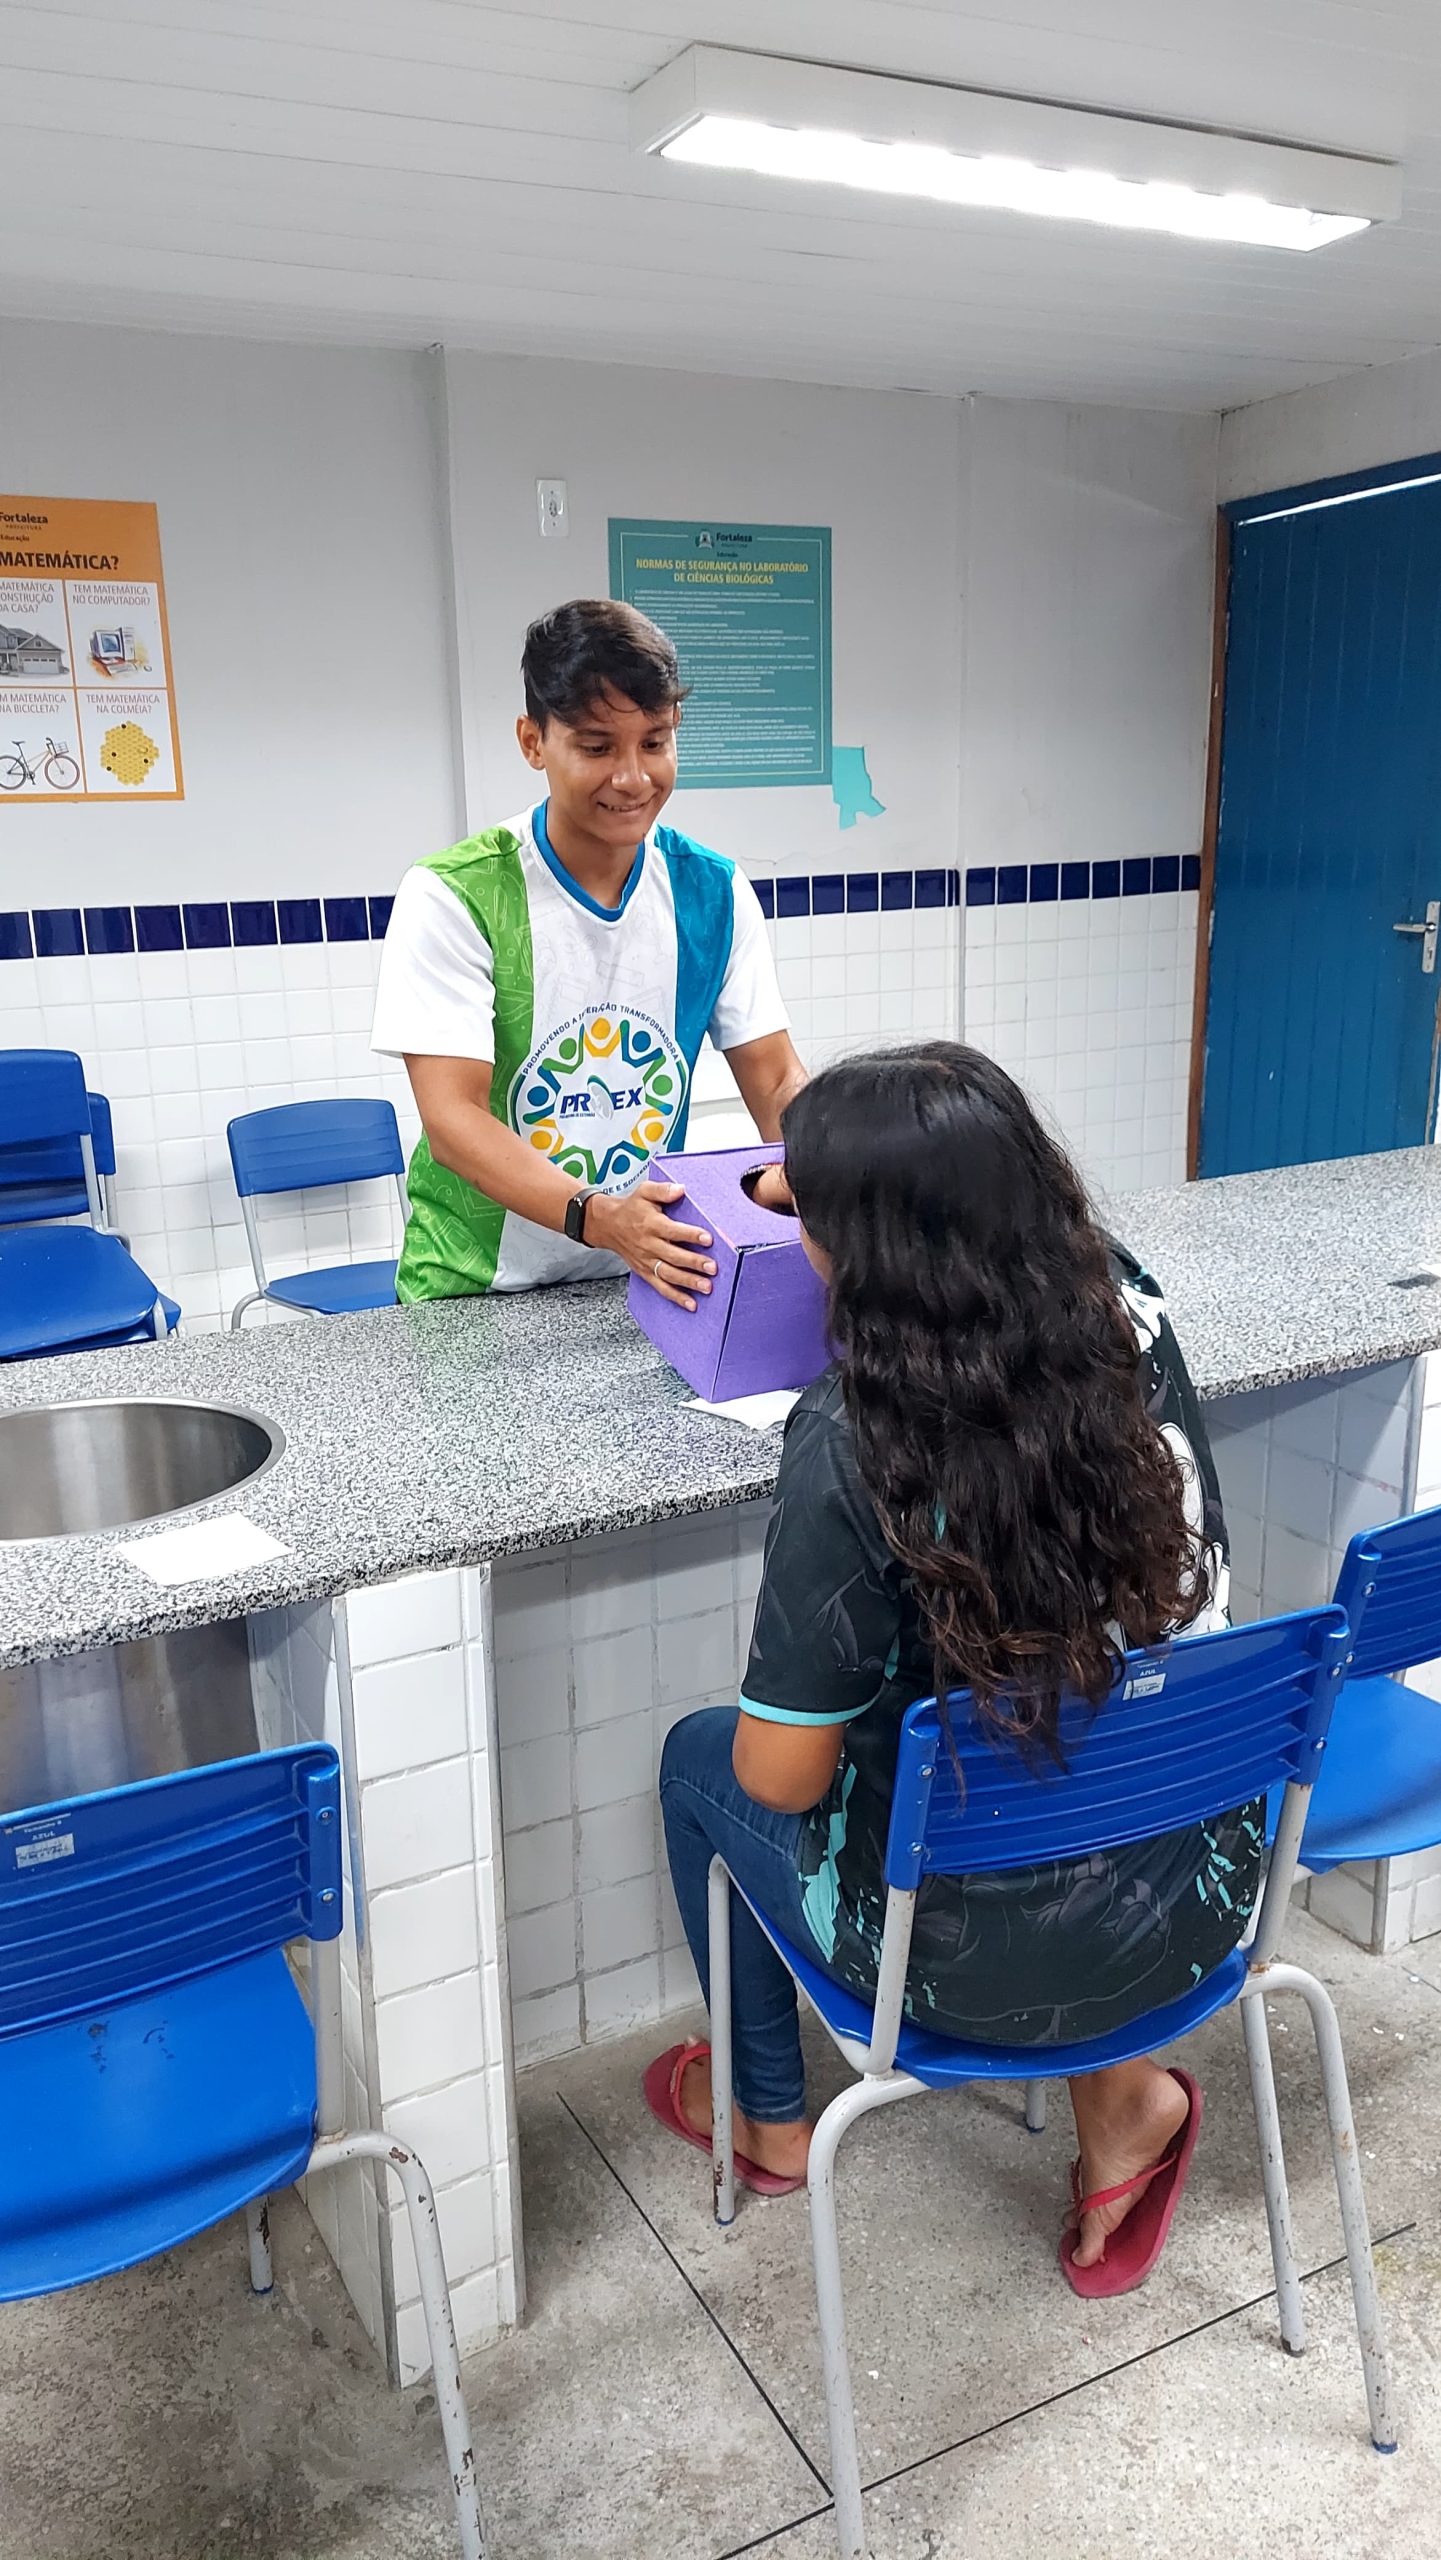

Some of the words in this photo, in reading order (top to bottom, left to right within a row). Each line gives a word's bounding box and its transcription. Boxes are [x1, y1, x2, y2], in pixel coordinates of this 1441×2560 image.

[0, 551, 119, 570] MATEMÁTICA?
[636, 558, 673, 569] NORMAS
[675, 560, 687, 570] DE
[688, 561, 738, 573] SEGURANÇA
[740, 562, 751, 572] NO
[753, 561, 808, 573] LABORATÓRIO
[674, 572, 685, 582] DE
[687, 571, 724, 583] CIÊNCIAS
[726, 572, 773, 584] BIOLÓGICAS
[74, 584, 91, 593] TEM
[94, 583, 148, 595] MATEMÁTICA
[0, 592, 54, 604] ONSTRUÇÃO
[73, 595, 86, 604] NO
[88, 595, 150, 606] COMPUTADOR?
[11, 603, 38, 613] CASA?
[11, 692, 66, 703] MATEMÁTICA
[87, 694, 104, 703] TEM
[106, 693, 160, 704] MATEMÁTICA
[14, 704, 59, 713] BICICLETA?
[96, 704, 109, 713] NA
[111, 703, 152, 714] COLMÉIA?
[523, 1021, 570, 1074] PROMOVENDO
[620, 1004, 678, 1060] TRANSFORMADORA
